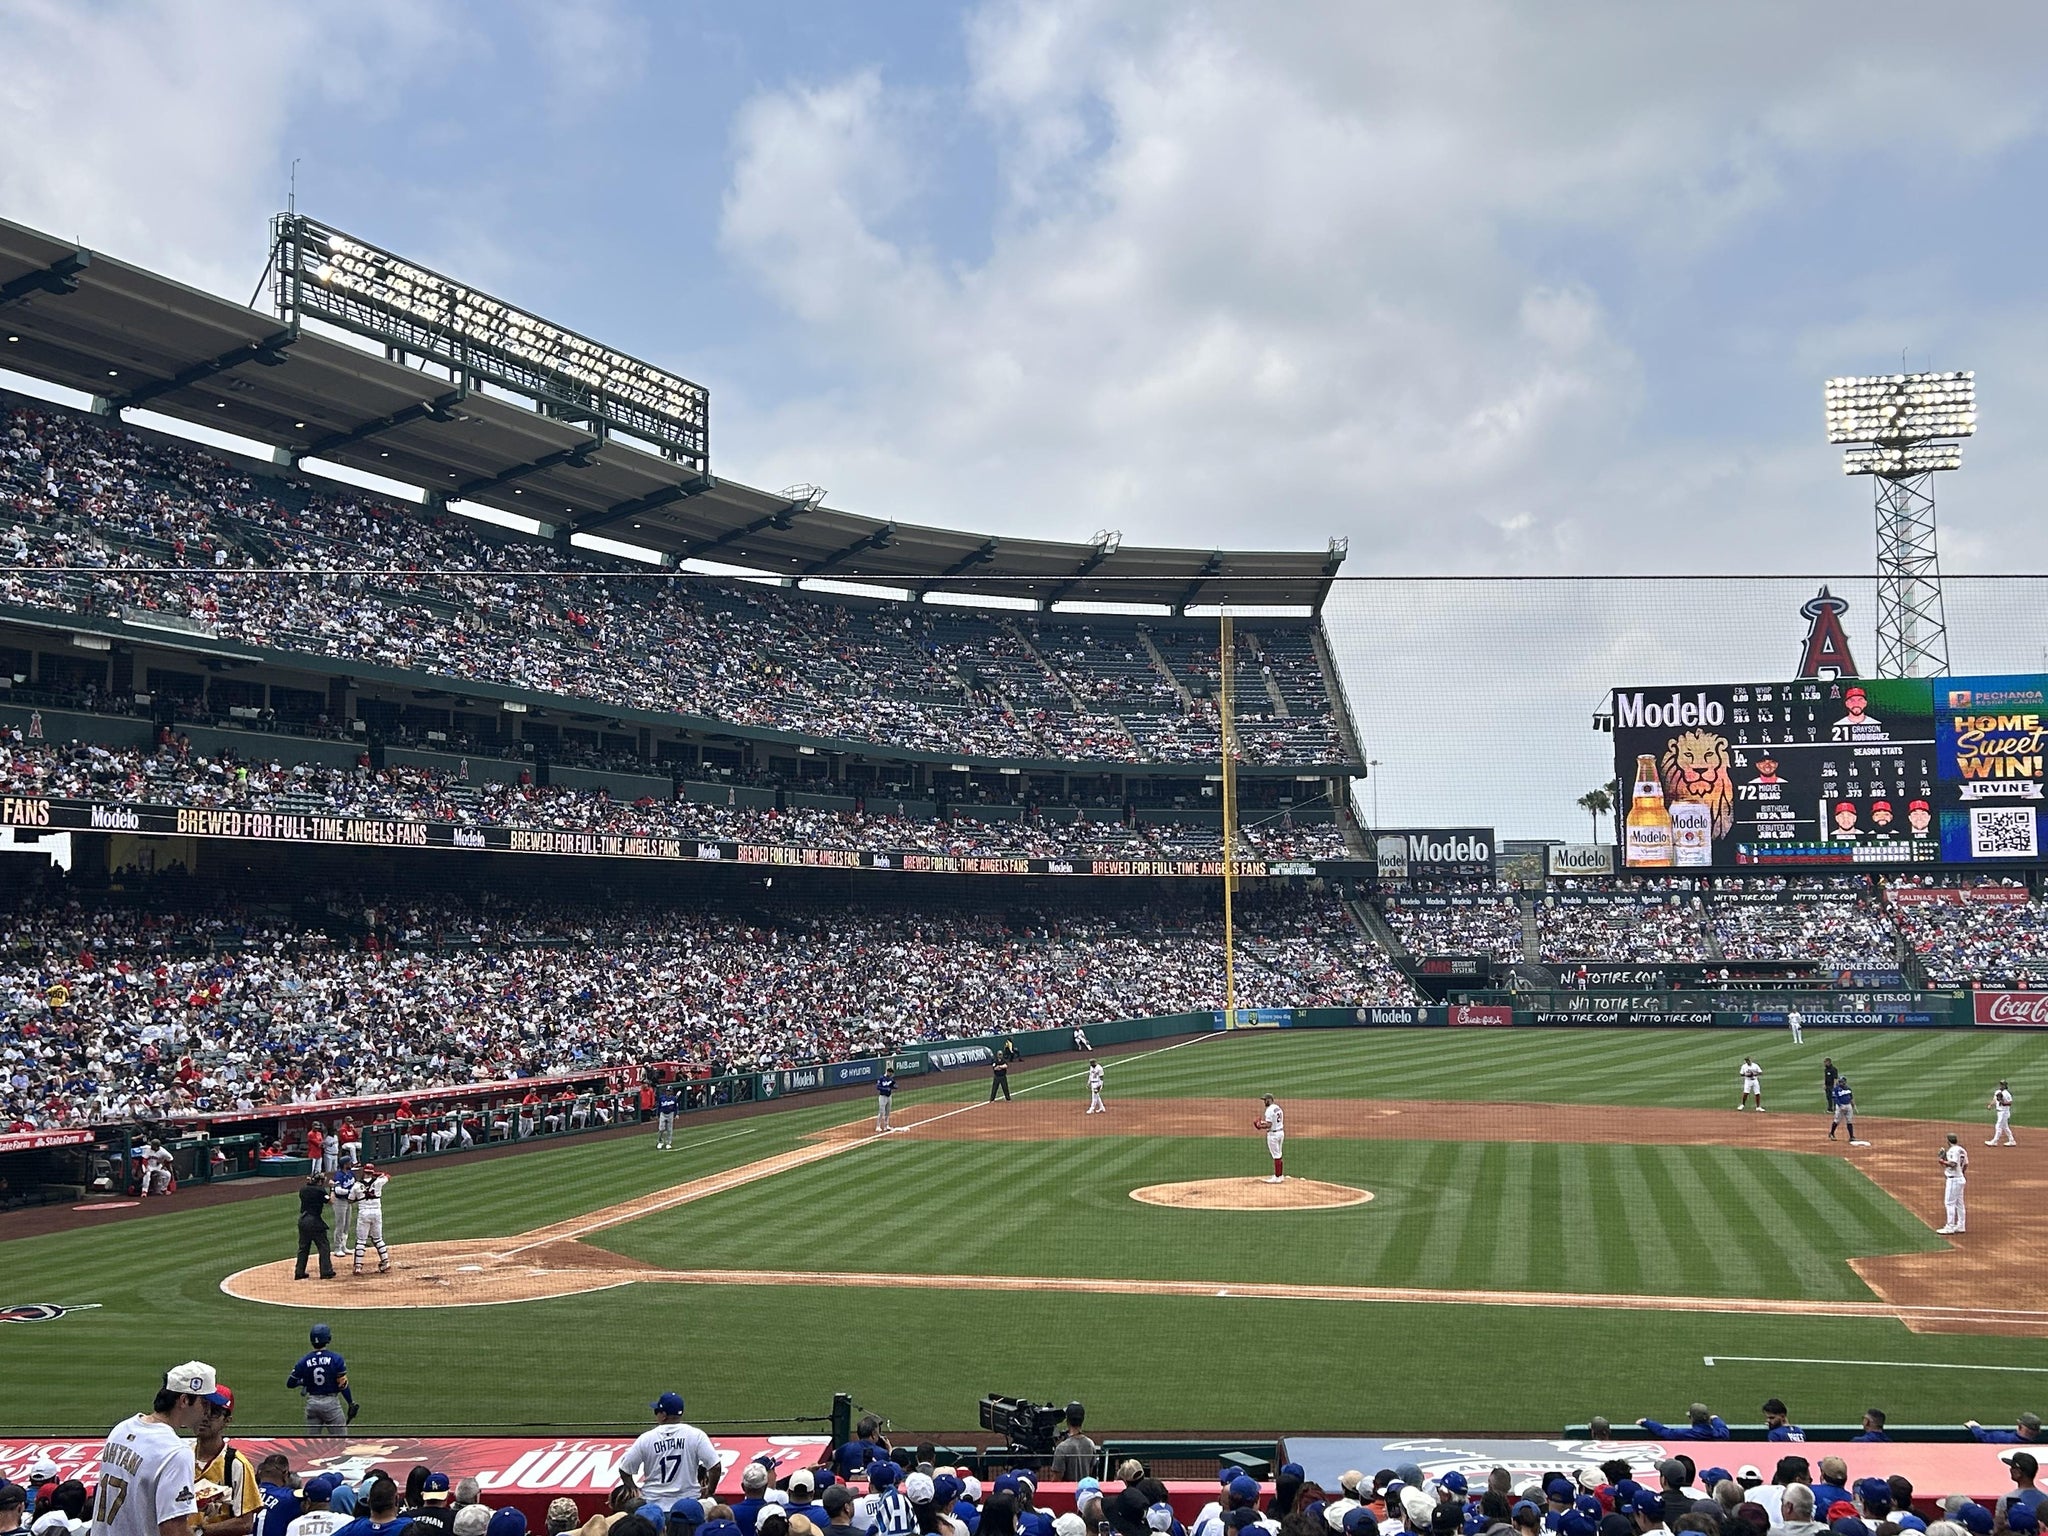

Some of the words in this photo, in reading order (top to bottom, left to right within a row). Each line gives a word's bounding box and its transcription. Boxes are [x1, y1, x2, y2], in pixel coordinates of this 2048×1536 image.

[1734, 687, 1747, 695] ERA
[1755, 686, 1772, 694] WHIP
[1782, 692, 1792, 700] 1.1
[1975, 691, 2043, 700] PECHANGA
[1617, 692, 1725, 728] Modelo
[1954, 714, 2040, 733] HOME
[1831, 726, 1850, 741] 21
[1852, 733, 1890, 741] RODRIGUEZ
[1957, 726, 2048, 758] Sweet
[1854, 748, 1880, 756] SEASON
[1882, 747, 1903, 755] STATS
[1957, 756, 2043, 778] WIN!
[1738, 785, 1757, 800] 72
[1973, 783, 2031, 793] IRVINE
[1758, 792, 1780, 800] ROJAS
[3, 798, 50, 826] FANS
[91, 805, 140, 829] Modelo
[177, 809, 241, 836] BREWED
[245, 814, 272, 837] FOR
[275, 815, 343, 841] FULL-TIME
[346, 819, 394, 844] ANGELS
[396, 822, 427, 845] FANS
[1672, 815, 1707, 829] Modelo
[1757, 824, 1785, 832] DEBUTED
[453, 827, 486, 848] Modelo
[510, 830, 553, 852] BREWED
[555, 833, 575, 853] FOR
[575, 834, 623, 856] FULL-TIME
[624, 838, 658, 856] ANGELS
[659, 840, 680, 857] FANS
[1632, 830, 1667, 843] Modelo
[738, 845, 768, 863] BREWED
[770, 847, 783, 863] FOR
[784, 848, 818, 865] FULL-TIME
[819, 850, 844, 866] ANGELS
[844, 852, 860, 866] FANS
[1409, 835, 1488, 862] Modelo
[904, 856, 930, 870] BREWED
[931, 856, 943, 871] FOR
[944, 857, 979, 872] FULL-TIME
[980, 858, 1008, 873] ANGELS
[1010, 859, 1028, 873] FANS
[1558, 850, 1605, 867] Modelo
[1048, 861, 1073, 873] Modelo
[1092, 862, 1129, 875] BREWED
[1132, 862, 1150, 875] FOR
[1152, 862, 1199, 875] FULL-TIME
[1201, 862, 1239, 875] ANGES
[1241, 862, 1266, 875] FANS
[1588, 896, 1608, 904] Modelo
[1820, 962, 1899, 970] 714TICKETS.COM
[1990, 995, 2048, 1022] Coca-C
[1372, 1010, 1412, 1024] Modelo
[1537, 1014, 1568, 1022] NITTO
[1572, 1014, 1618, 1022] TIRE.COM
[1630, 1014, 1661, 1022] NITTO
[1664, 1013, 1712, 1022] TIRE.COM
[1760, 1015, 1783, 1023] tickets
[1905, 1015, 1929, 1023] tickets
[941, 1054, 957, 1067] MLB
[955, 1049, 986, 1064] NETWORK
[849, 1066, 871, 1076] HYUNDAI
[792, 1071, 815, 1088] Modelo
[319, 1357, 331, 1365] KIM
[313, 1367, 325, 1386] 6
[654, 1438, 685, 1454] OHTANI
[103, 1442, 143, 1477] OHTANI
[659, 1454, 682, 1484] 17
[96, 1473, 129, 1525] 17
[299, 1521, 334, 1536] BETTS
